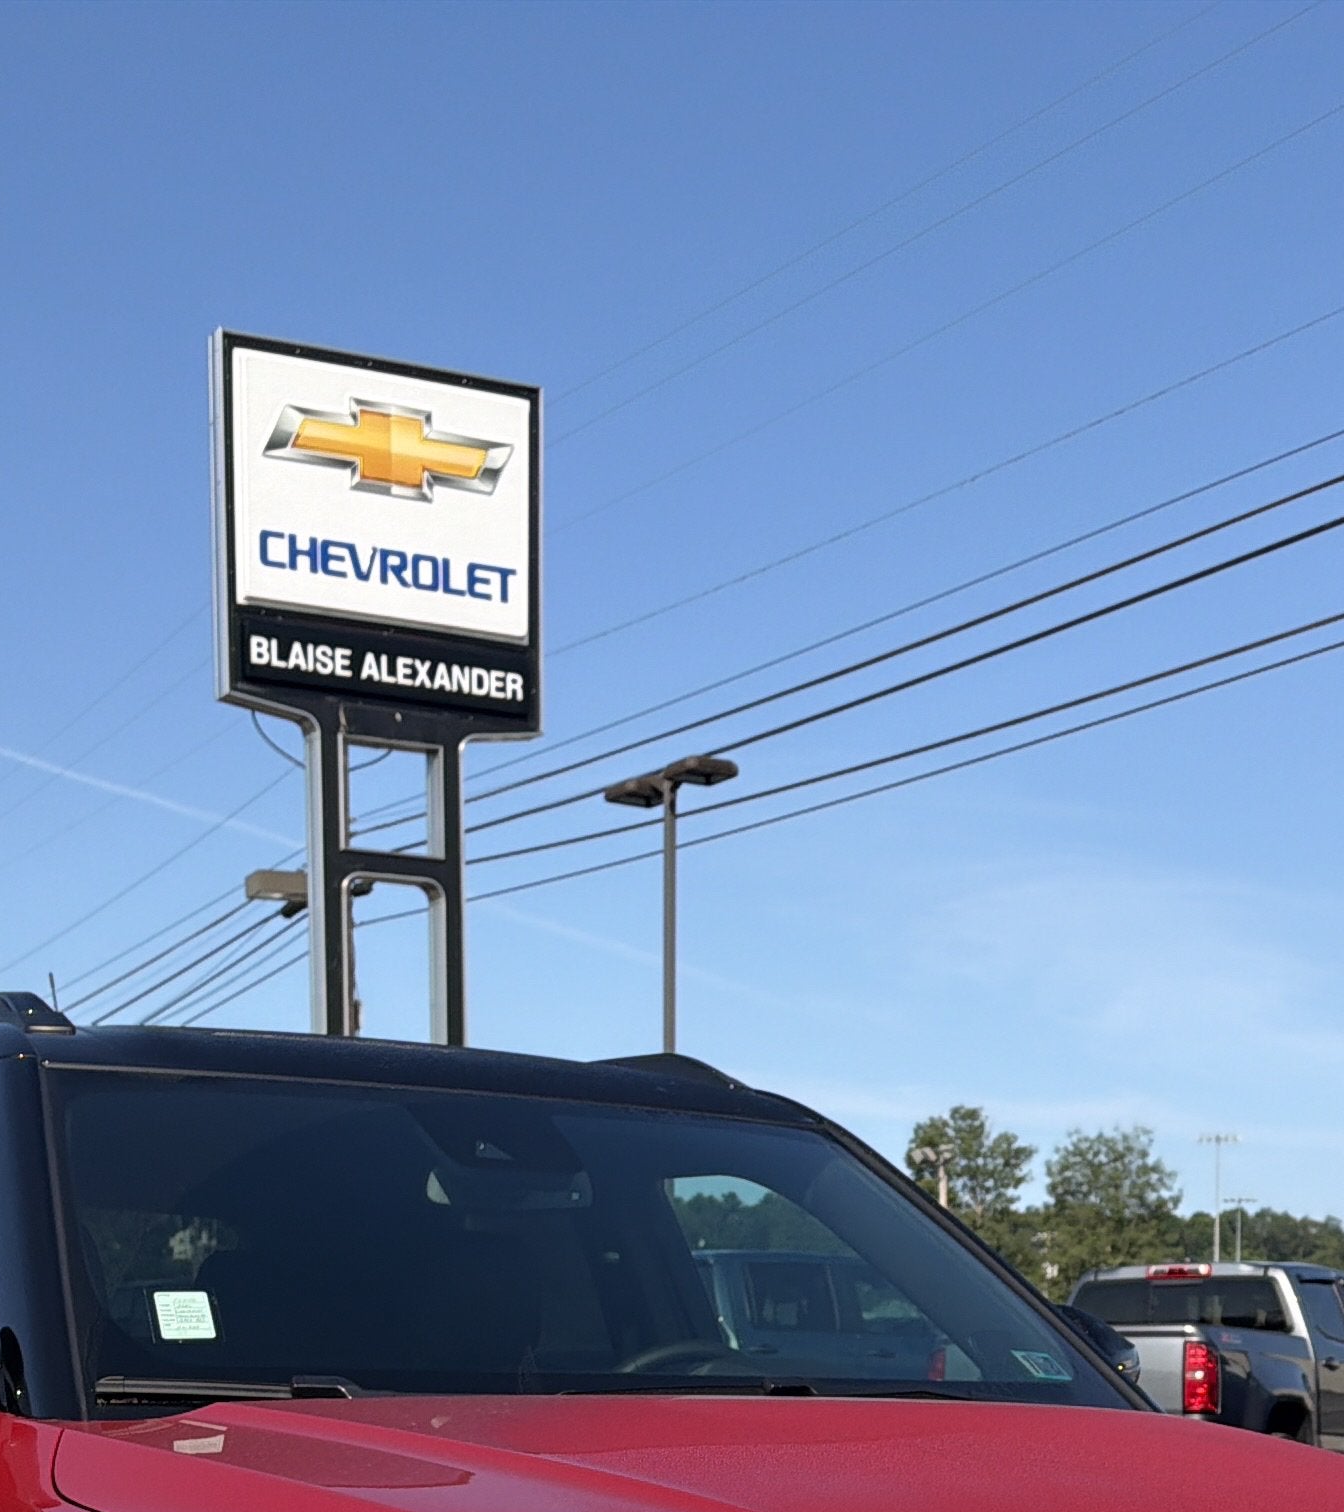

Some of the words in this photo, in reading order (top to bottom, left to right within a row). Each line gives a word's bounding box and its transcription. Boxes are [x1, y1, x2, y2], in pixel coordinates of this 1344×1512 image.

[259, 529, 517, 604] CHEVROLET
[249, 634, 353, 677] BLAISE
[360, 650, 524, 702] ALEXANDER
